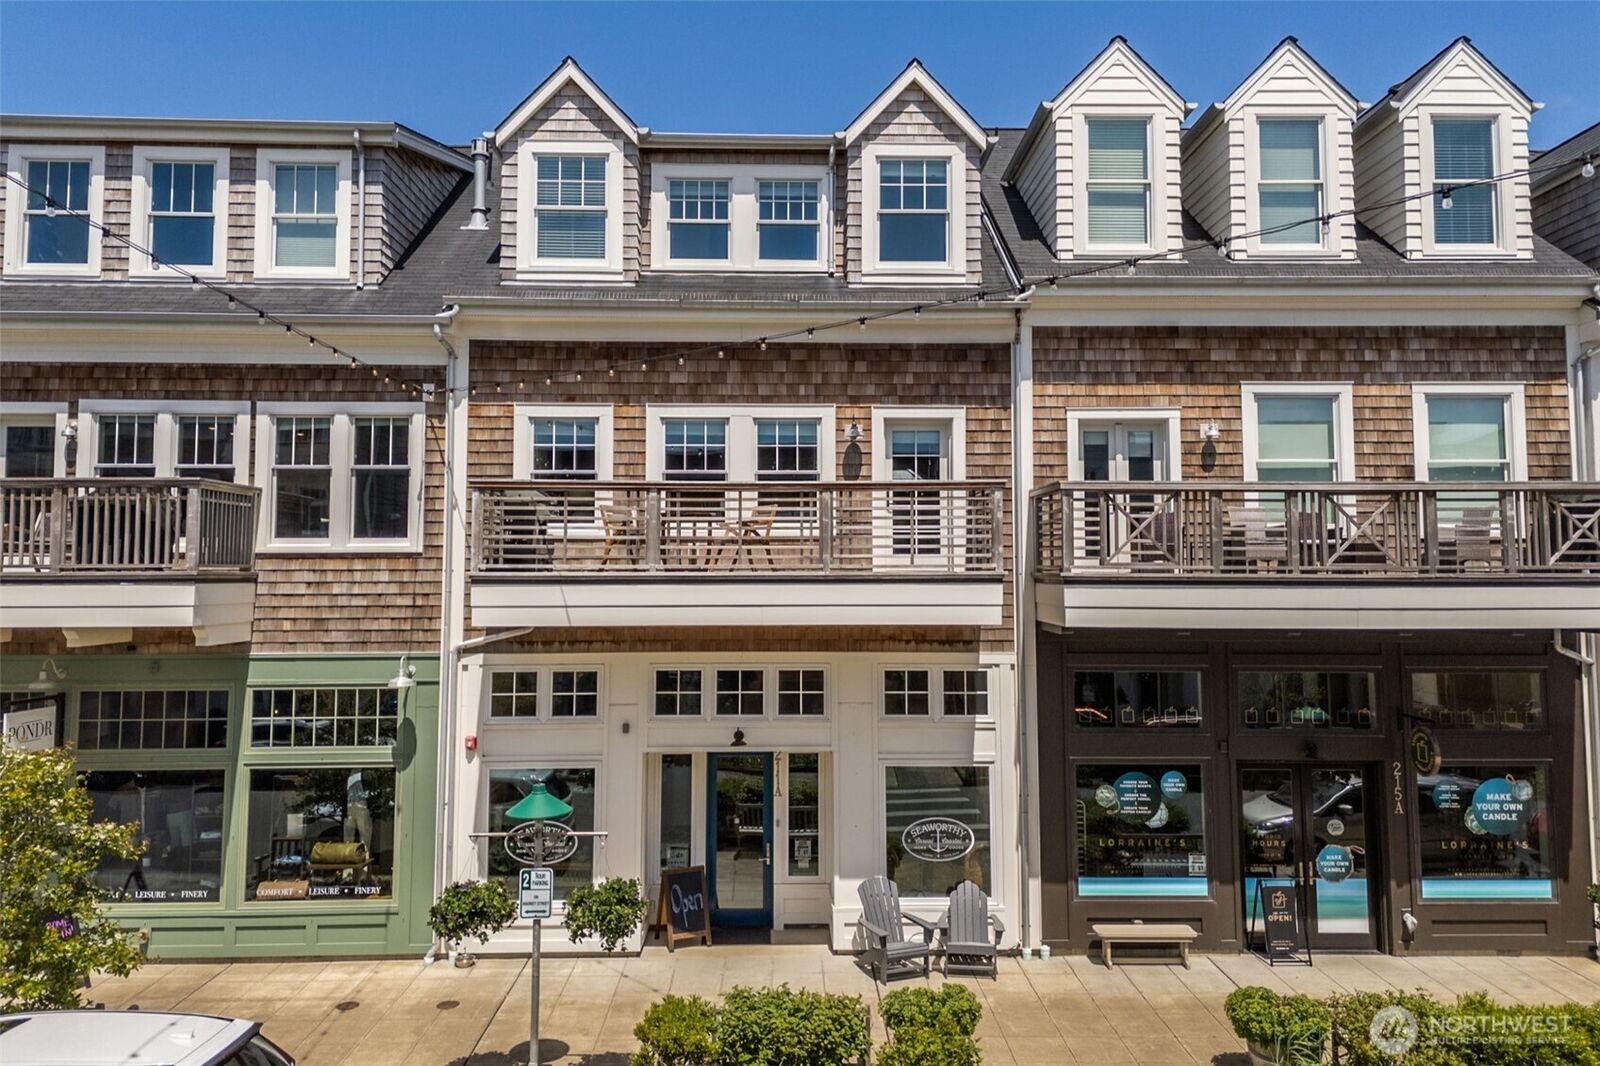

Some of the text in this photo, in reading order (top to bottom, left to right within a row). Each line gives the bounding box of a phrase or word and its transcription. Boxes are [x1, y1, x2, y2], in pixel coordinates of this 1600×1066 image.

[8, 720, 52, 744] PONDR
[1392, 761, 1404, 814] 215A
[1486, 793, 1512, 801] MAKE
[1476, 803, 1523, 811] YOUR OWN
[1482, 813, 1518, 821] CANDLE
[910, 823, 967, 837] SEAWORTHY
[1099, 839, 1187, 847] LORRAINE'S
[1441, 840, 1528, 849] LORRAINE'S
[522, 873, 530, 888] 2
[135, 890, 208, 898] LEISURE FINERY
[256, 886, 382, 896] COMFORT LEISURE FINERY
[670, 884, 704, 928] Open
